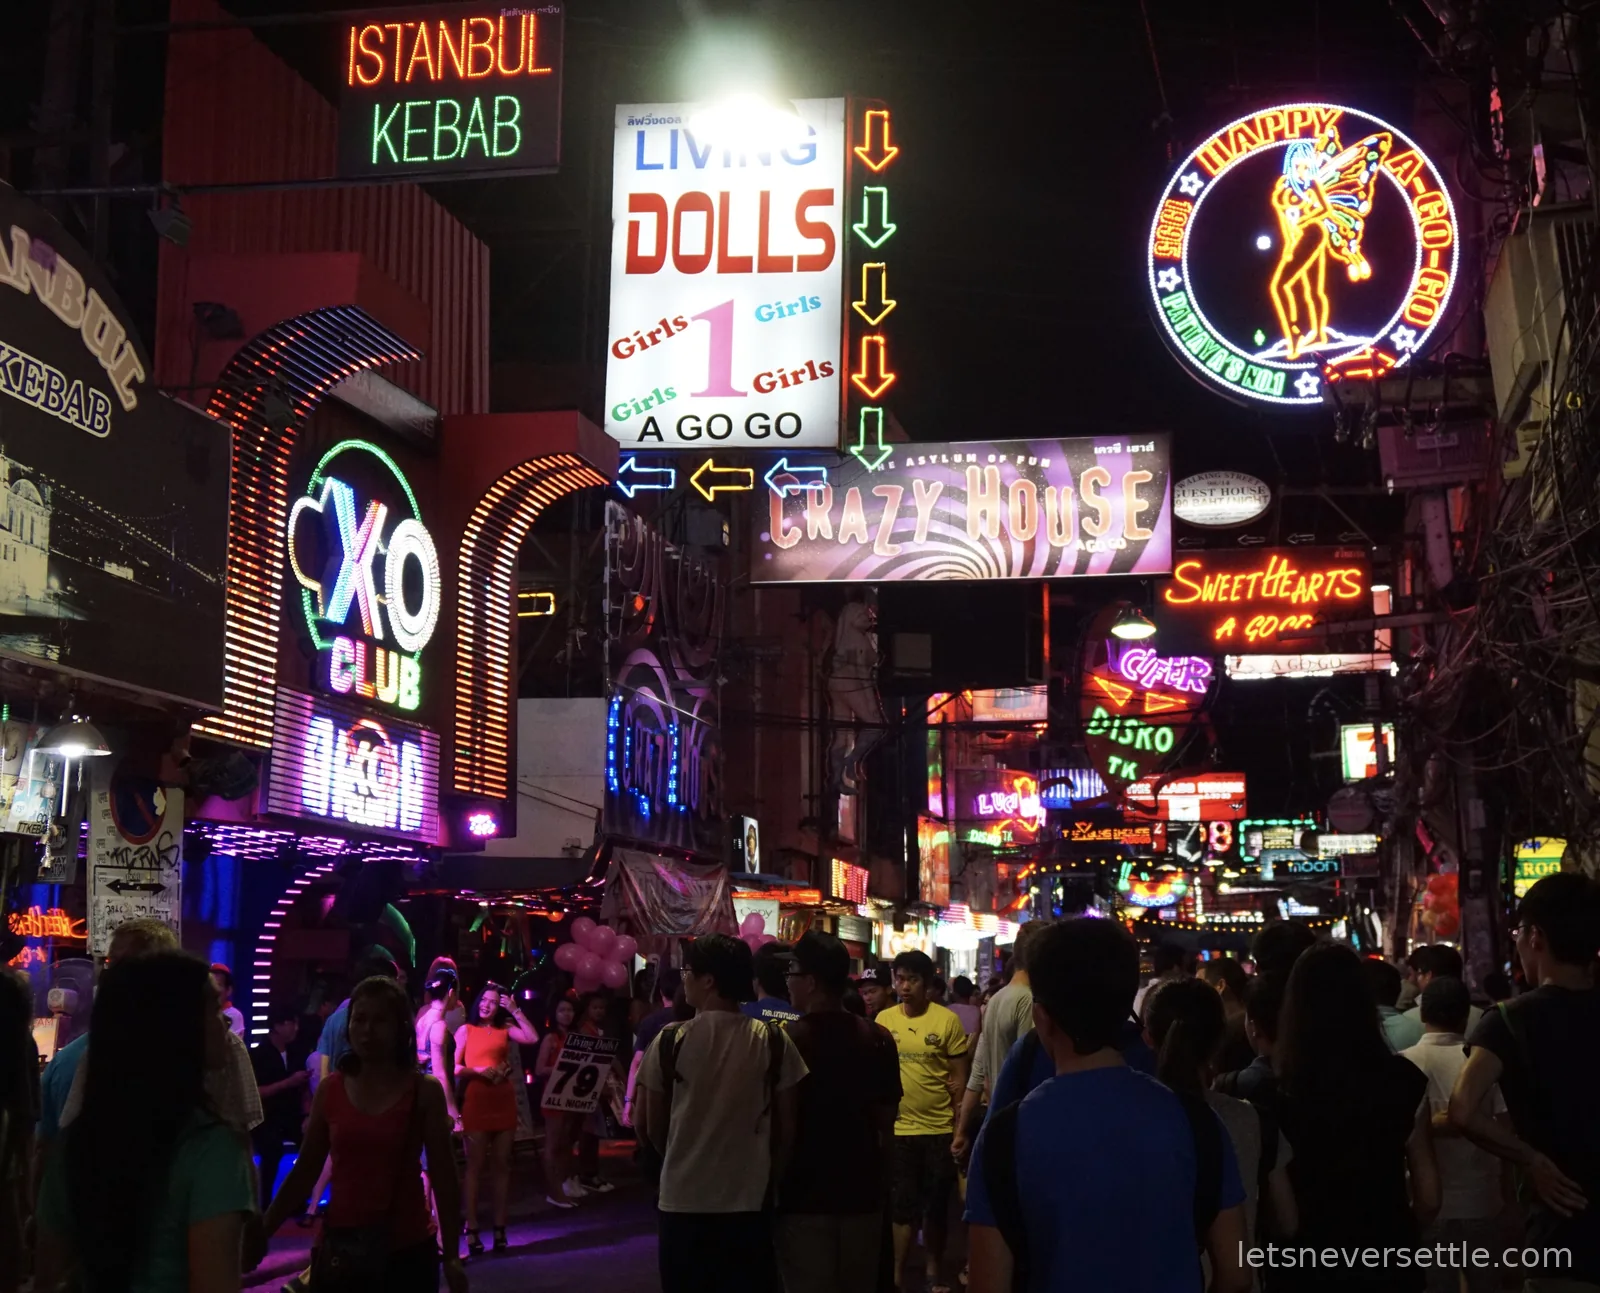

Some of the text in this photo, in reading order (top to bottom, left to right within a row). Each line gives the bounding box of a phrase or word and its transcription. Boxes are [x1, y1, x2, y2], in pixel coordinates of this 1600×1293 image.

[348, 16, 552, 86] ISTANBUL
[371, 95, 522, 165] KEBAB
[1194, 107, 1344, 177] HAPPY
[625, 187, 836, 275] DOLLS
[1384, 149, 1452, 326] A-GO-GO
[753, 294, 823, 323] Girls
[611, 314, 689, 360] Girls
[690, 298, 749, 398] 1
[0, 337, 112, 438] KEBAB
[752, 359, 835, 394] Girls
[611, 386, 678, 422] Girls
[636, 411, 803, 442] A GO GO
[906, 453, 977, 467] ASYLUM
[987, 453, 1008, 464] OF
[1016, 454, 1052, 468] FUN
[1177, 472, 1221, 489] WALKING
[1220, 485, 1266, 497] HOUSE
[769, 465, 1154, 557] CRAZY HOUSE
[323, 476, 441, 652] XO
[1216, 616, 1236, 640] A
[330, 636, 422, 711] CLUB
[1108, 755, 1138, 781] TK
[566, 1033, 596, 1053] Living
[552, 1061, 600, 1098] 79
[545, 1097, 562, 1107] ALL
